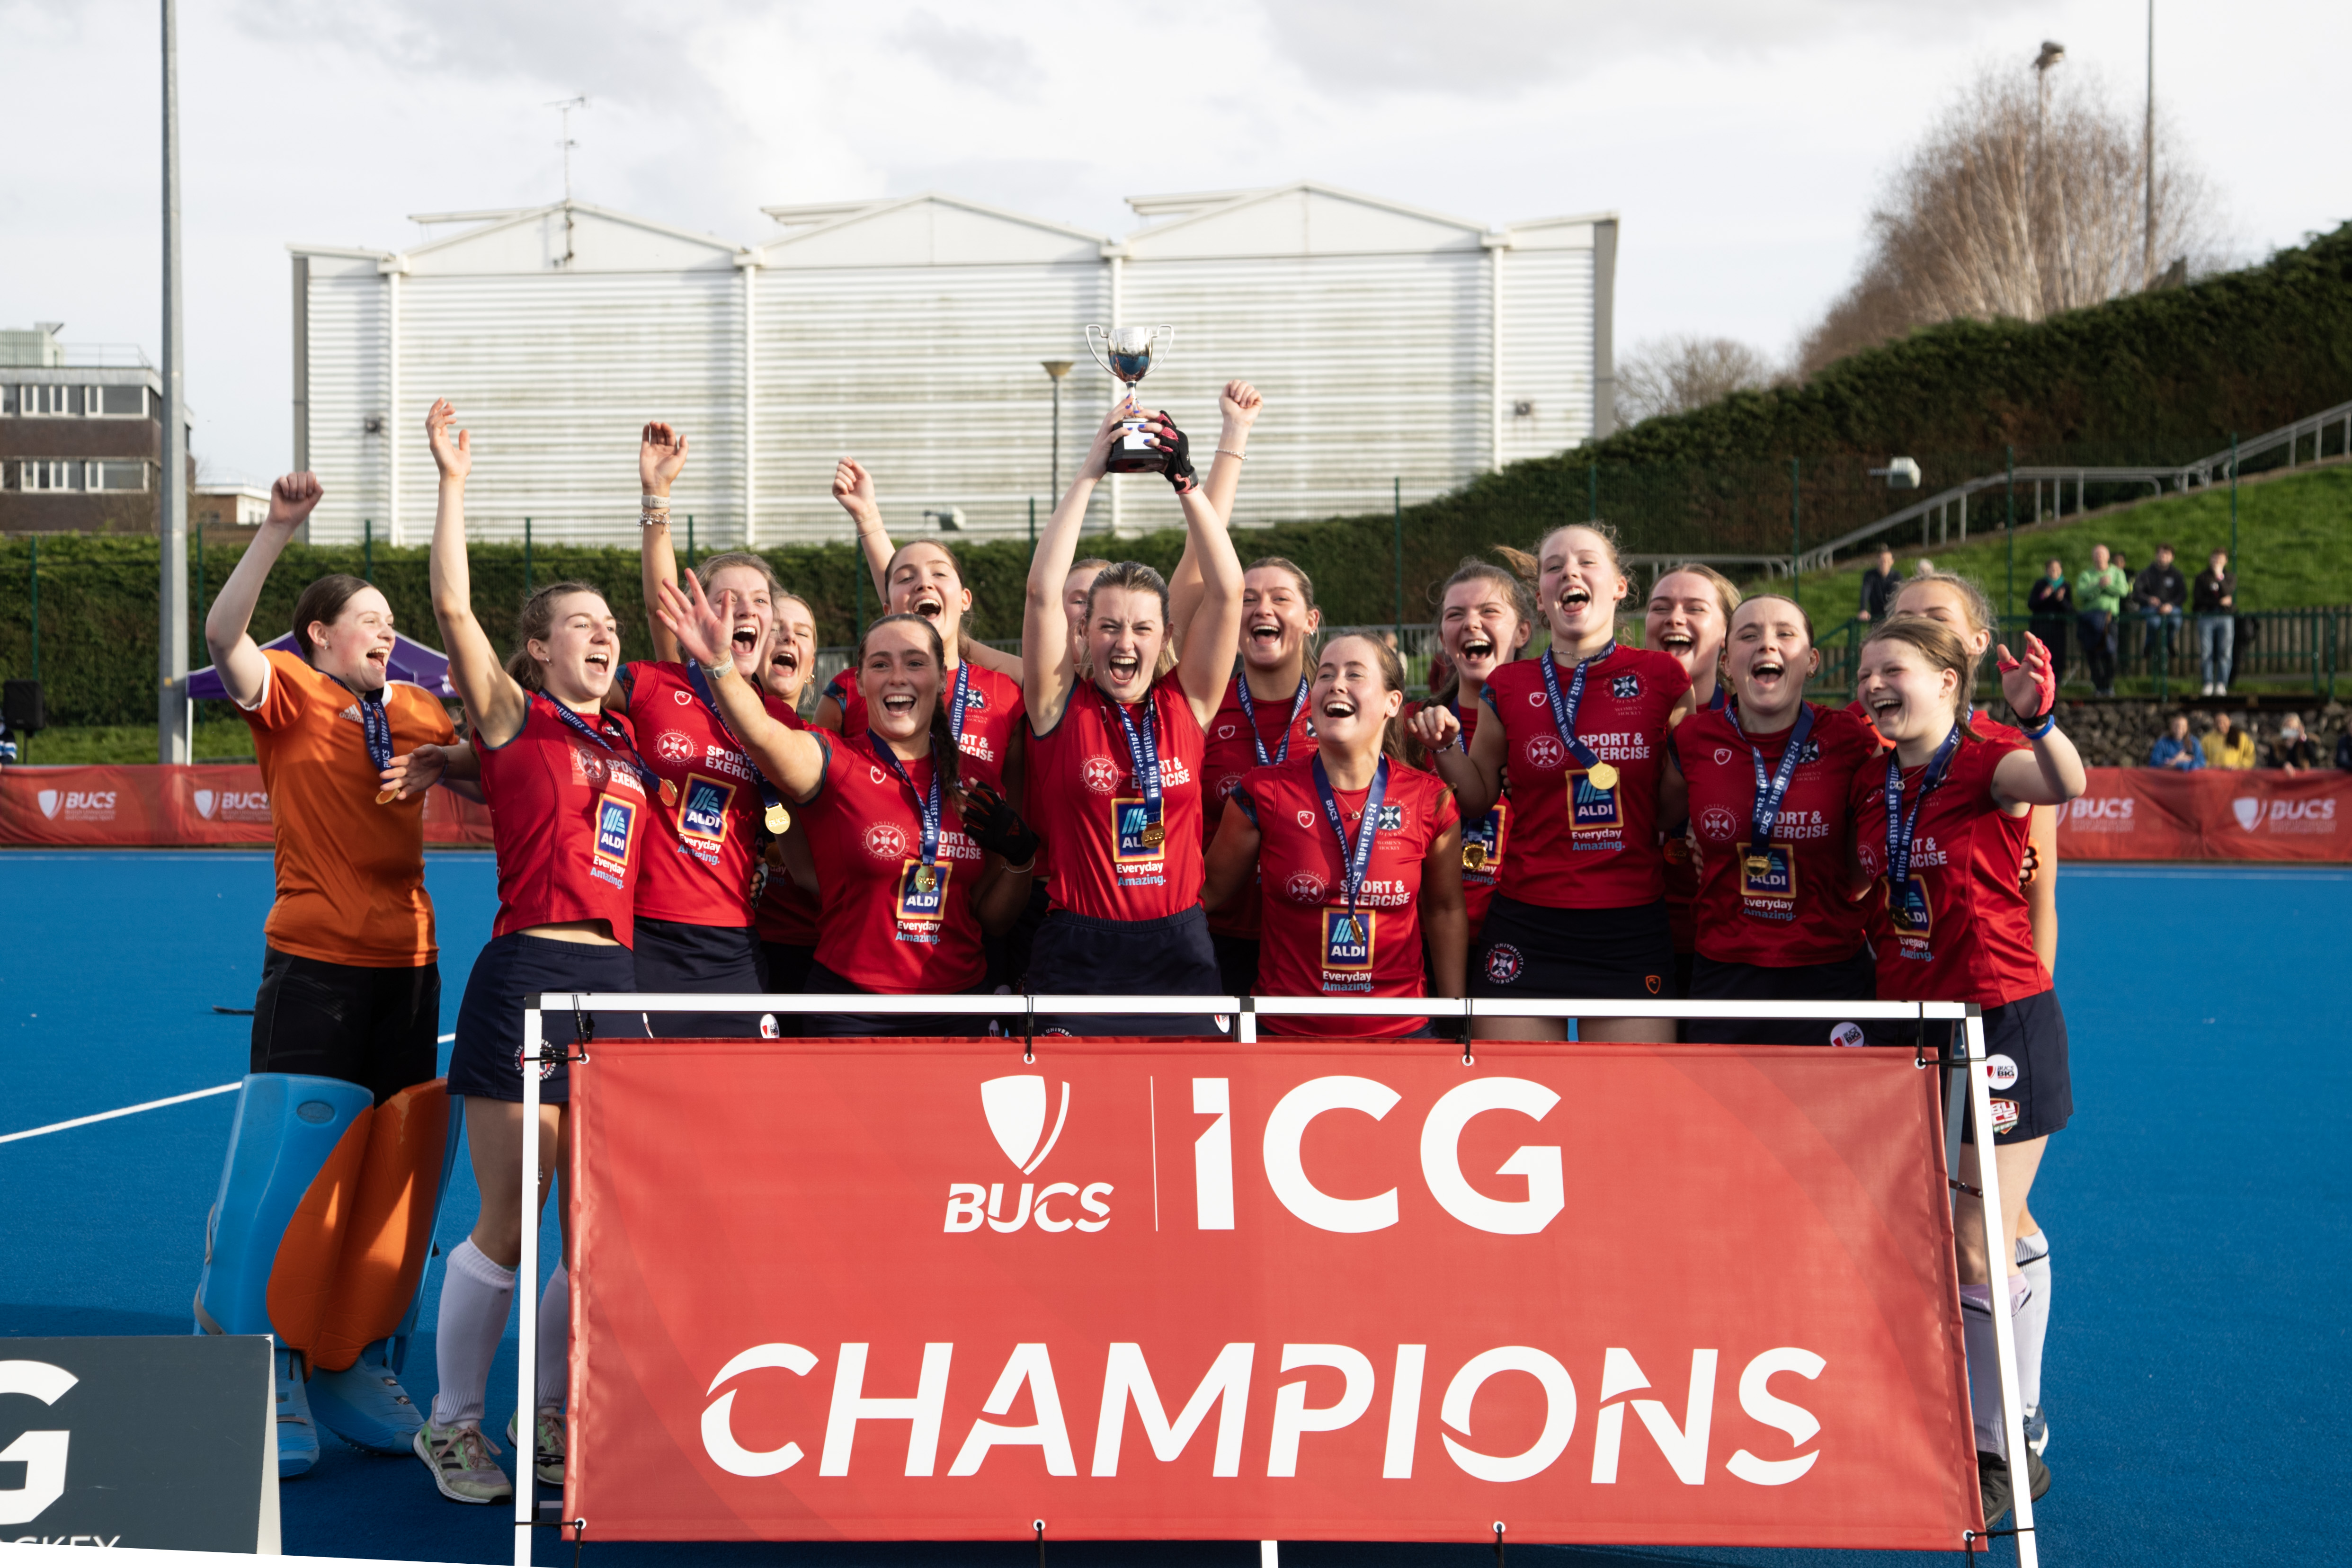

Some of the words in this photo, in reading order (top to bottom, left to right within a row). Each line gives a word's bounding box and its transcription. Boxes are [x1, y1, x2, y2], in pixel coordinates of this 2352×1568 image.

[1544, 665, 1553, 679] AND
[1571, 663, 1585, 695] 2023-24
[958, 683, 966, 696] AND
[1548, 680, 1564, 723] UNIVERSITIES
[1124, 717, 1133, 731] AND
[584, 729, 597, 738] AND
[1143, 716, 1155, 762] UNIVERSITIES
[1560, 723, 1576, 748] BRITISH
[1578, 733, 1630, 747] SPORT
[1633, 733, 1644, 745] &
[980, 737, 989, 749] &
[1589, 746, 1650, 760] XERCISE
[705, 756, 757, 785] EXERCI
[894, 760, 908, 780] BUCS
[1174, 757, 1183, 770] &
[1131, 769, 1190, 789] ERCISE
[1149, 766, 1158, 798] BRITISH
[1757, 764, 1770, 794] TROPHY
[1759, 811, 1773, 835] BUCS
[1769, 775, 1786, 805] TROPHY
[1782, 740, 1800, 775] 2023-24
[66, 791, 116, 809] BUCS
[1889, 793, 1897, 810] AND
[1578, 804, 1613, 817] ALDI
[2072, 798, 2134, 818] BUCS
[2272, 799, 2337, 819] BUCS
[687, 811, 722, 828] ALDI
[1300, 812, 1311, 820] PL
[1775, 811, 1808, 825] ORT
[1811, 810, 1822, 825] &
[873, 820, 911, 840] UNIVERSITY
[924, 809, 934, 840] BRITISH
[1326, 799, 1338, 821] BUCS
[1335, 826, 1347, 854] TROPHY
[1376, 820, 1411, 837] DINBURGH
[1771, 823, 1829, 839] ERCISE
[601, 833, 624, 850] ALDI
[1571, 829, 1622, 840] Everyday
[679, 833, 721, 854] Everyday
[1123, 837, 1144, 848] AL
[1351, 872, 1361, 894] BUCS
[1356, 838, 1369, 865] TROPHY
[1363, 803, 1378, 836] 2023-24
[1572, 839, 1626, 851] Amazing.
[1925, 837, 1936, 851] &
[677, 844, 720, 865] Amazing.
[1910, 851, 1948, 868] RCISE
[593, 855, 625, 877] Everyday
[1116, 861, 1163, 875] Everyday
[1896, 850, 1907, 882] BRITISH
[590, 867, 624, 890] Amazing.
[1117, 874, 1166, 886] Amazing.
[1462, 873, 1496, 885] azing.
[1340, 880, 1392, 893] SORT
[1395, 880, 1405, 893] &
[906, 895, 939, 907] ALDI
[1340, 892, 1410, 906] EERCISE
[1743, 897, 1793, 911] Everyday
[1743, 908, 1796, 921] Amazing.
[1907, 912, 1927, 923] LDI
[897, 920, 941, 933] Everyday
[895, 931, 941, 945] Amazing.
[1331, 945, 1365, 957] ALDI
[1495, 943, 1524, 966] UNIVERSITY
[1323, 971, 1372, 983] Everyday
[1487, 969, 1522, 984] EDINBURGH
[1322, 982, 1374, 992] Amazing.
[515, 1044, 524, 1058] THE
[515, 1062, 522, 1070] OF
[944, 1183, 1114, 1233] BUCS
[701, 1343, 1826, 1485] CHAMPIONS
